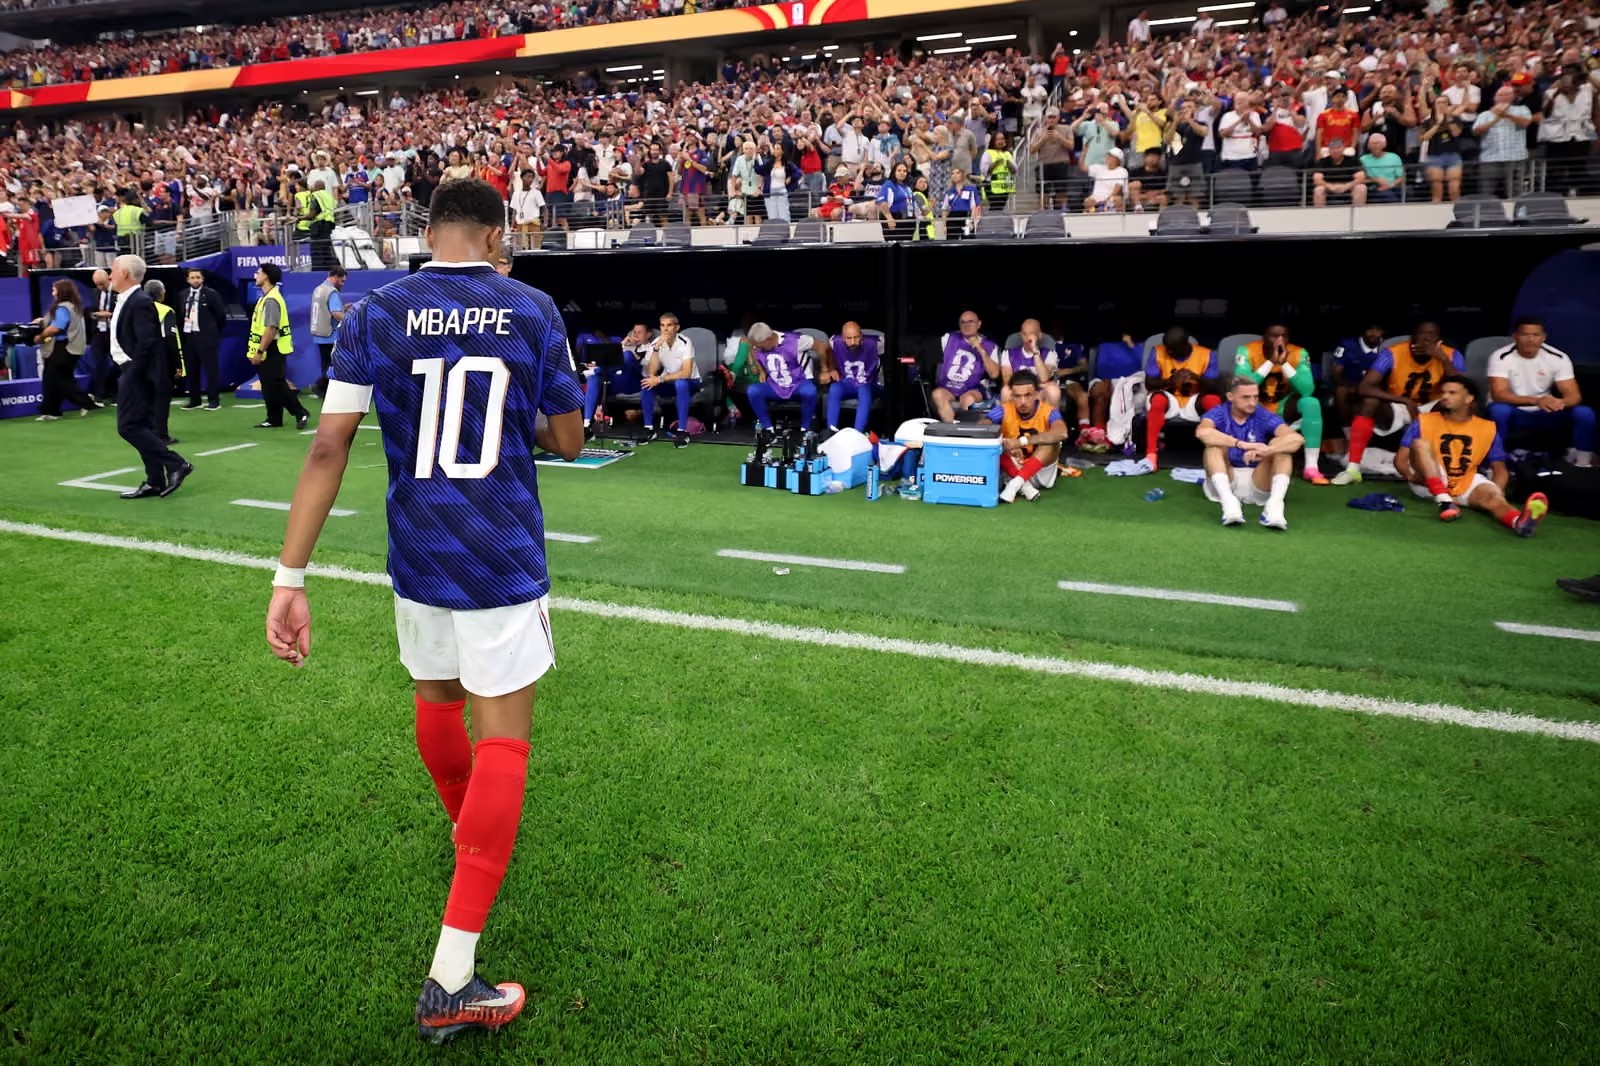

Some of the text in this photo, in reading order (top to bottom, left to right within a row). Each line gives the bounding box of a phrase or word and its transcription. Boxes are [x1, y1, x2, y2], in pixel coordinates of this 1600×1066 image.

[237, 256, 257, 267] FIFA
[407, 307, 513, 336] MBAPPE
[2, 395, 36, 406] WORLD
[411, 356, 511, 479] 10
[935, 473, 985, 484] POWERADE
